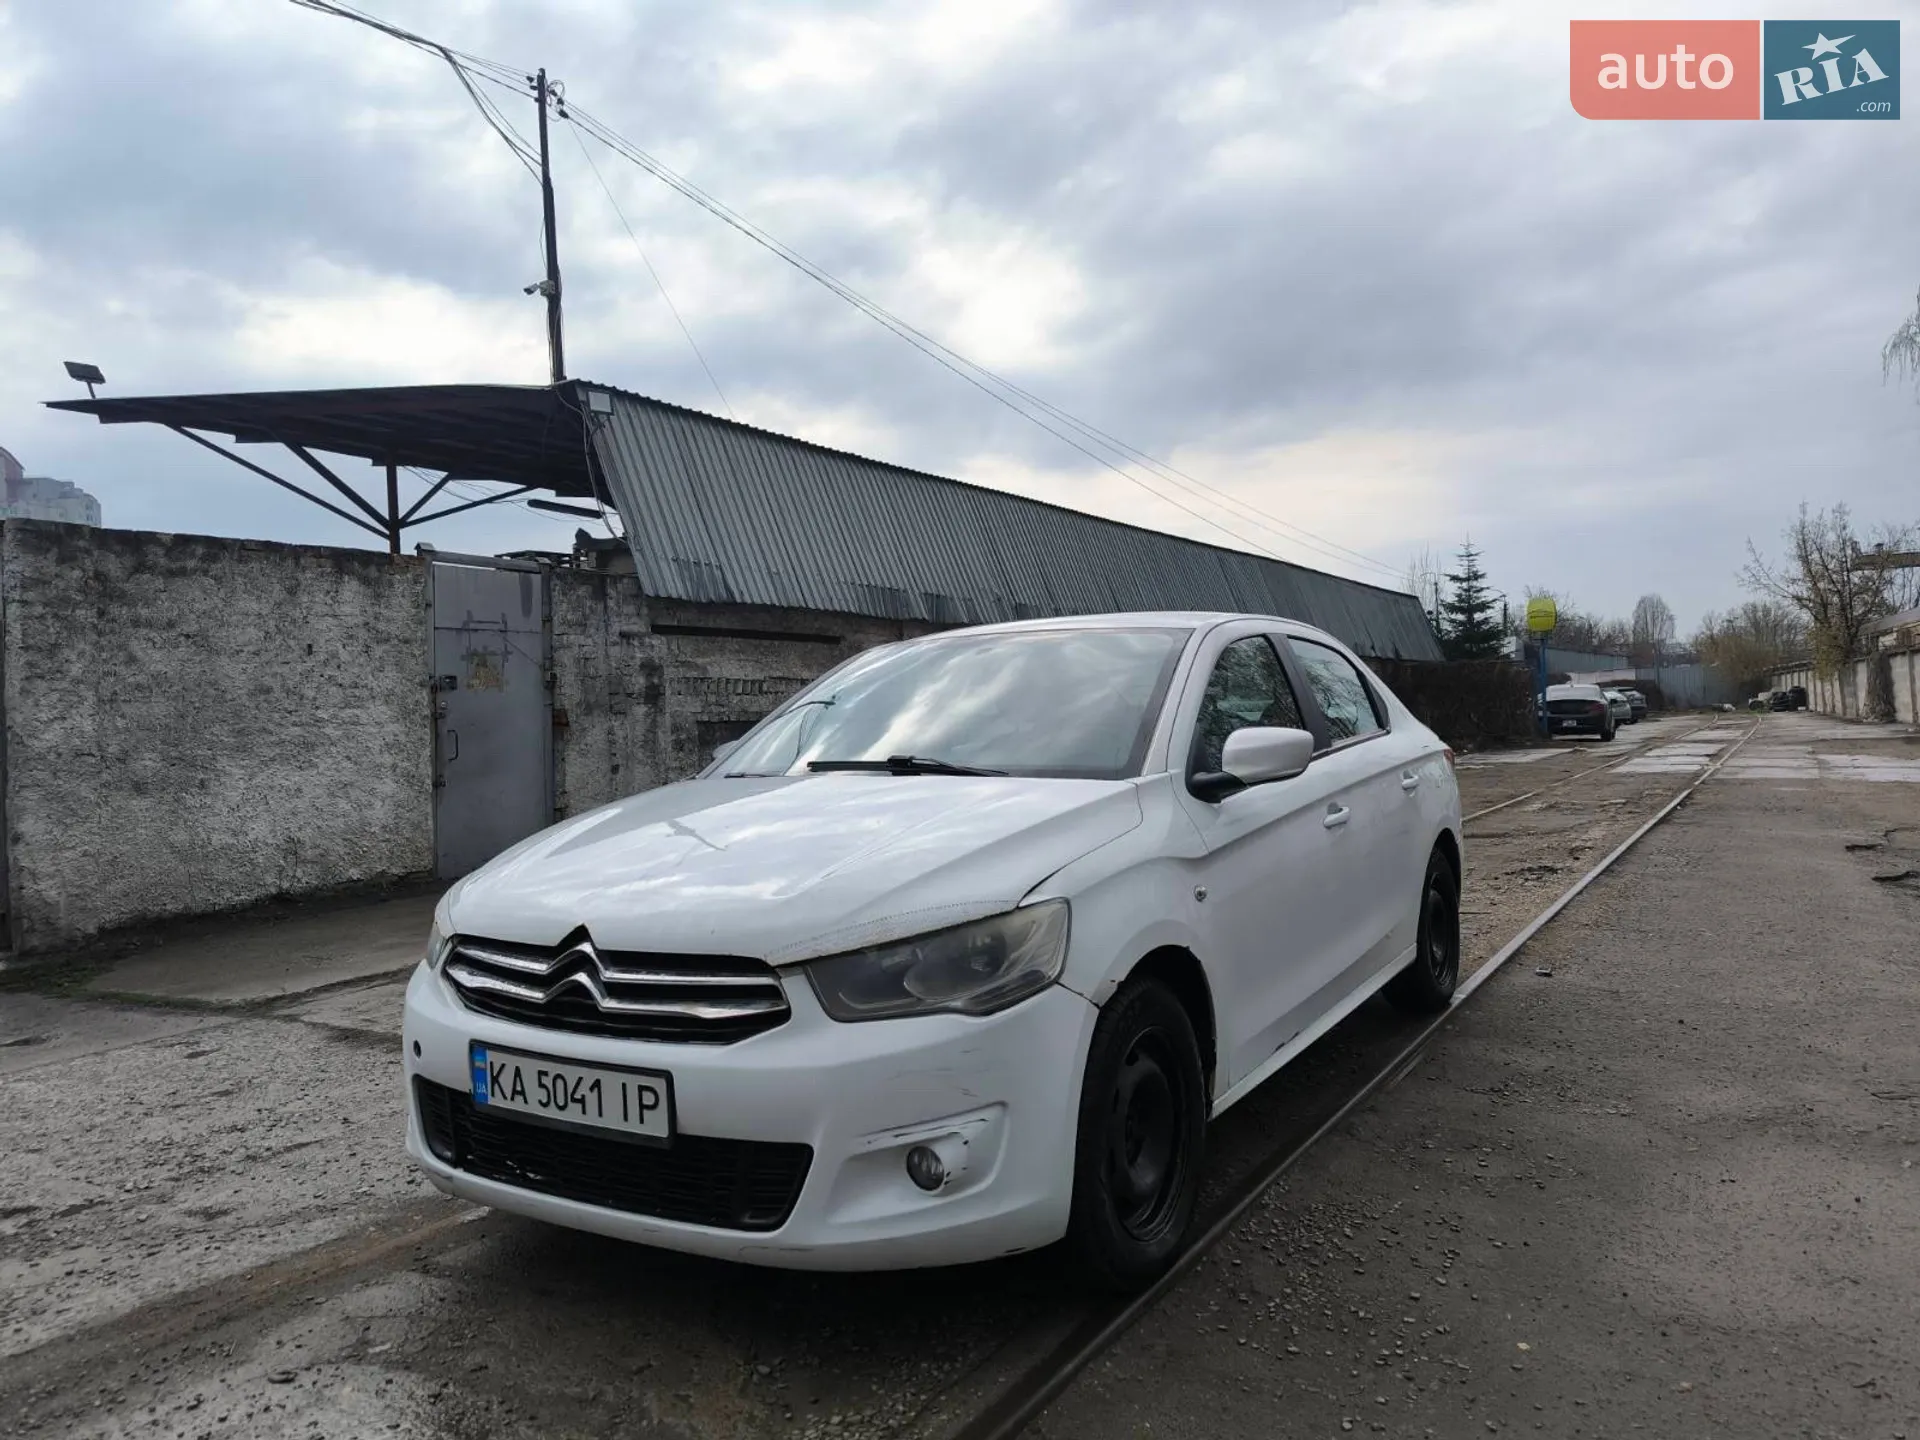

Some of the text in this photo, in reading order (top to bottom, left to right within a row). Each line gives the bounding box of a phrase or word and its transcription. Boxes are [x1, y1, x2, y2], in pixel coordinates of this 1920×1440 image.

[476, 1081, 488, 1095] UA
[489, 1061, 660, 1125] KA 5041 IP
